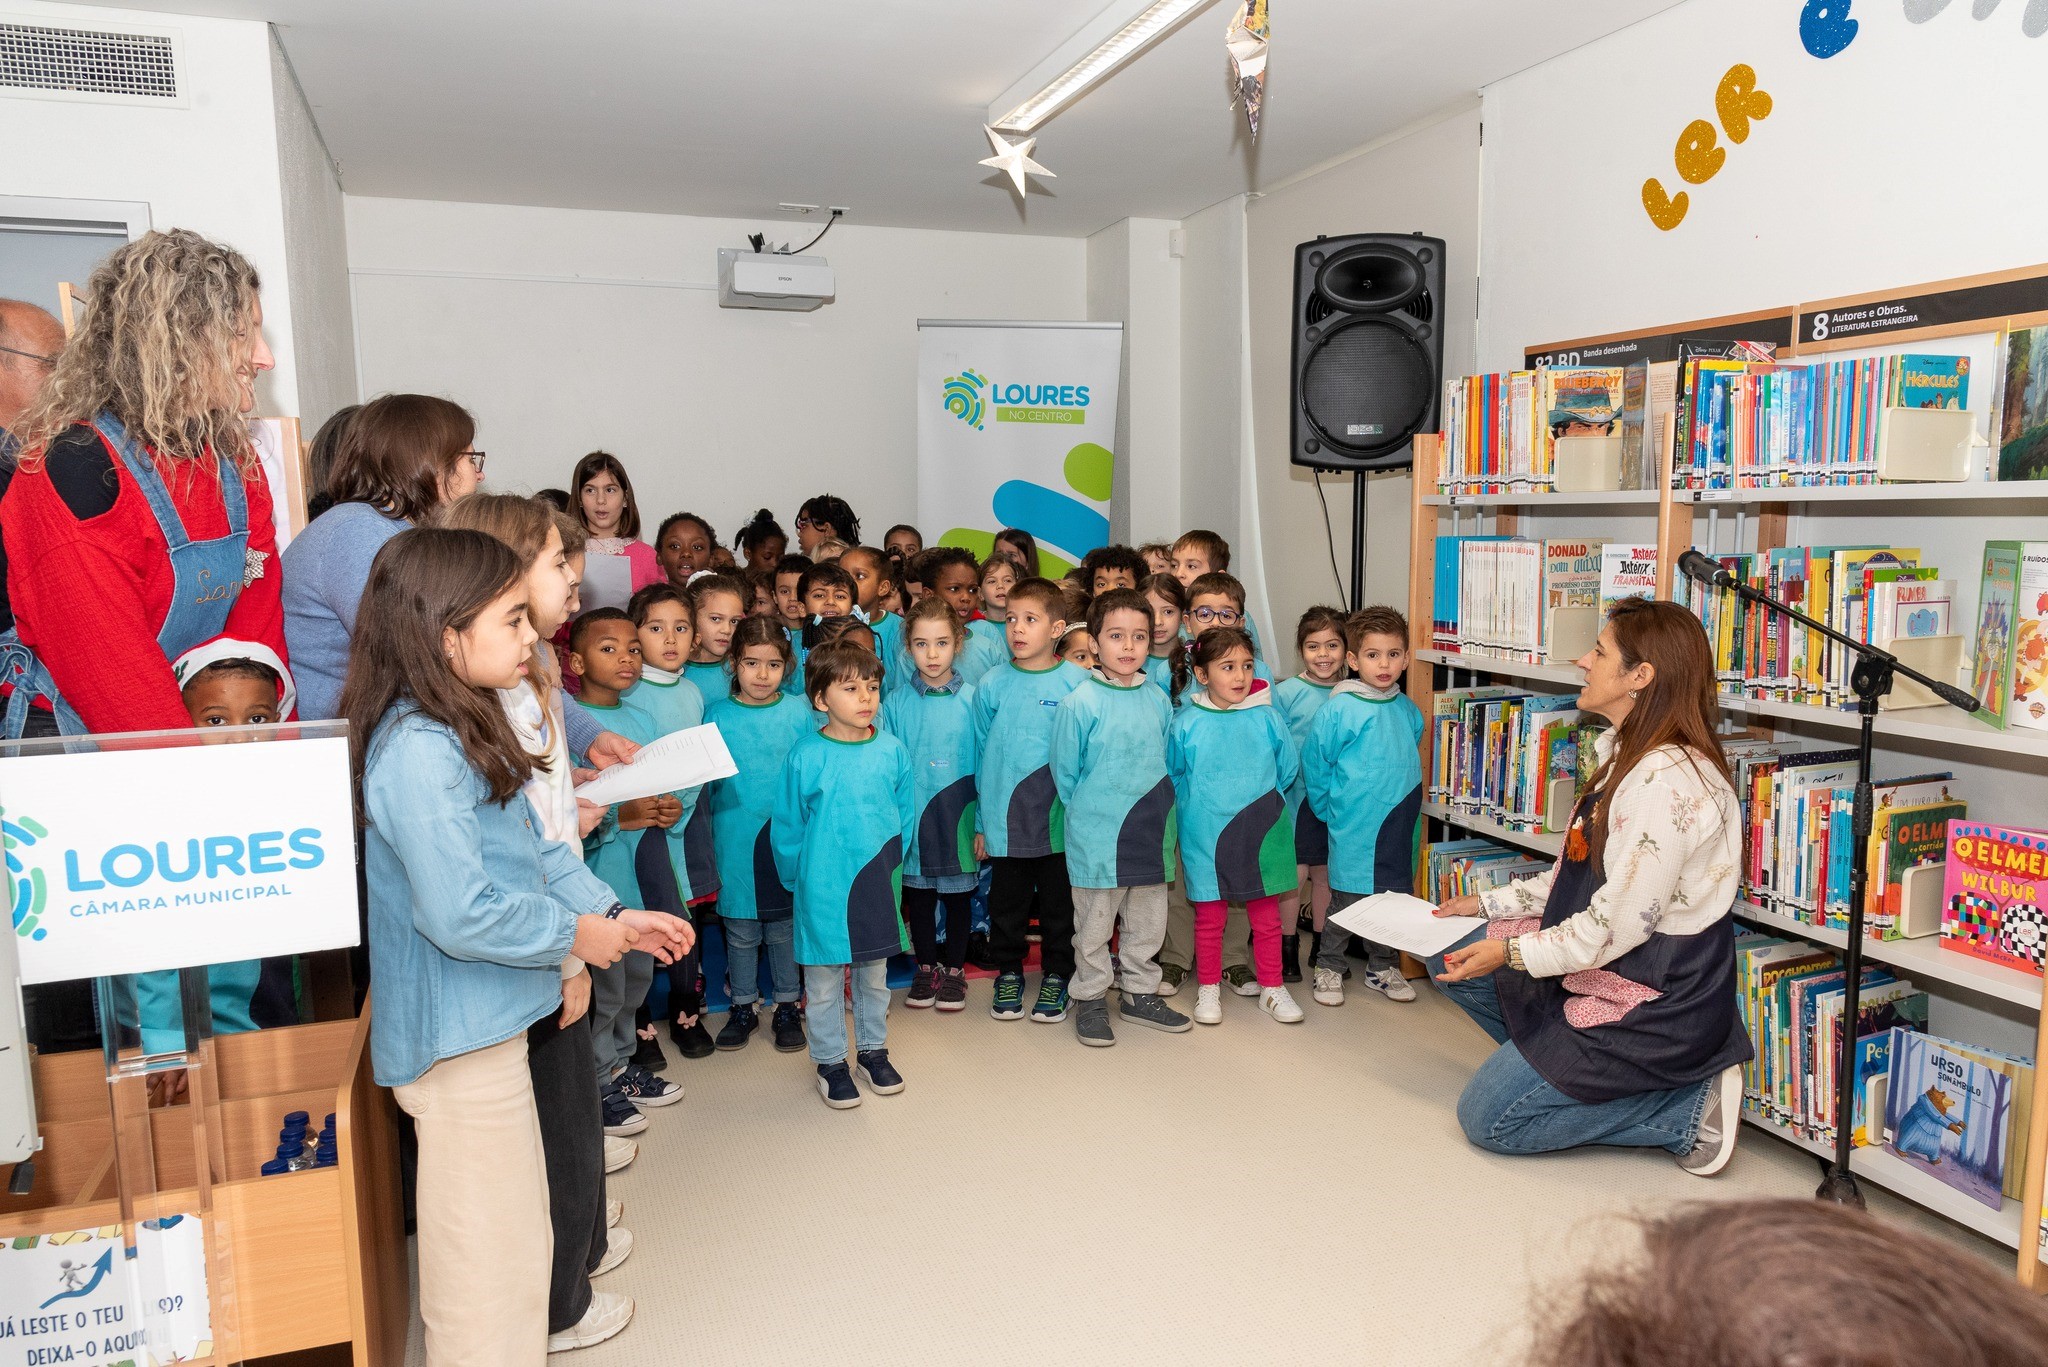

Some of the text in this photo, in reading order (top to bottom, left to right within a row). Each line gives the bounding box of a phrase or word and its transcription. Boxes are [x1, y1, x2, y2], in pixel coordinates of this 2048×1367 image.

[1831, 314, 1919, 334] LITERATURA ESTRANGEIRA
[1832, 305, 1907, 323] Autores e Obras.
[1812, 313, 1829, 341] 8
[1558, 351, 1580, 367] BD
[1583, 342, 1638, 358] Banda desenhada
[1554, 376, 1622, 390] BLUEBERRY
[992, 383, 1090, 407] LOURES
[1009, 410, 1072, 422] NO CENTRO
[1548, 544, 1587, 558] DONALD
[1620, 560, 1651, 575] Astérix
[1898, 825, 1911, 845] O
[1918, 840, 1944, 852] corrida
[1955, 837, 1974, 858] O
[65, 827, 326, 892] LOURES
[1962, 870, 2037, 902] WILBUR
[70, 883, 292, 918] CÂMARA MUNICIPAL
[1931, 1054, 1964, 1078] URSO
[1938, 1072, 1982, 1098] SONÂMBULO
[22, 1314, 68, 1336] LESTE
[76, 1312, 87, 1329] O
[92, 1305, 124, 1326] TEU
[28, 1341, 97, 1367] DEIXA-O
